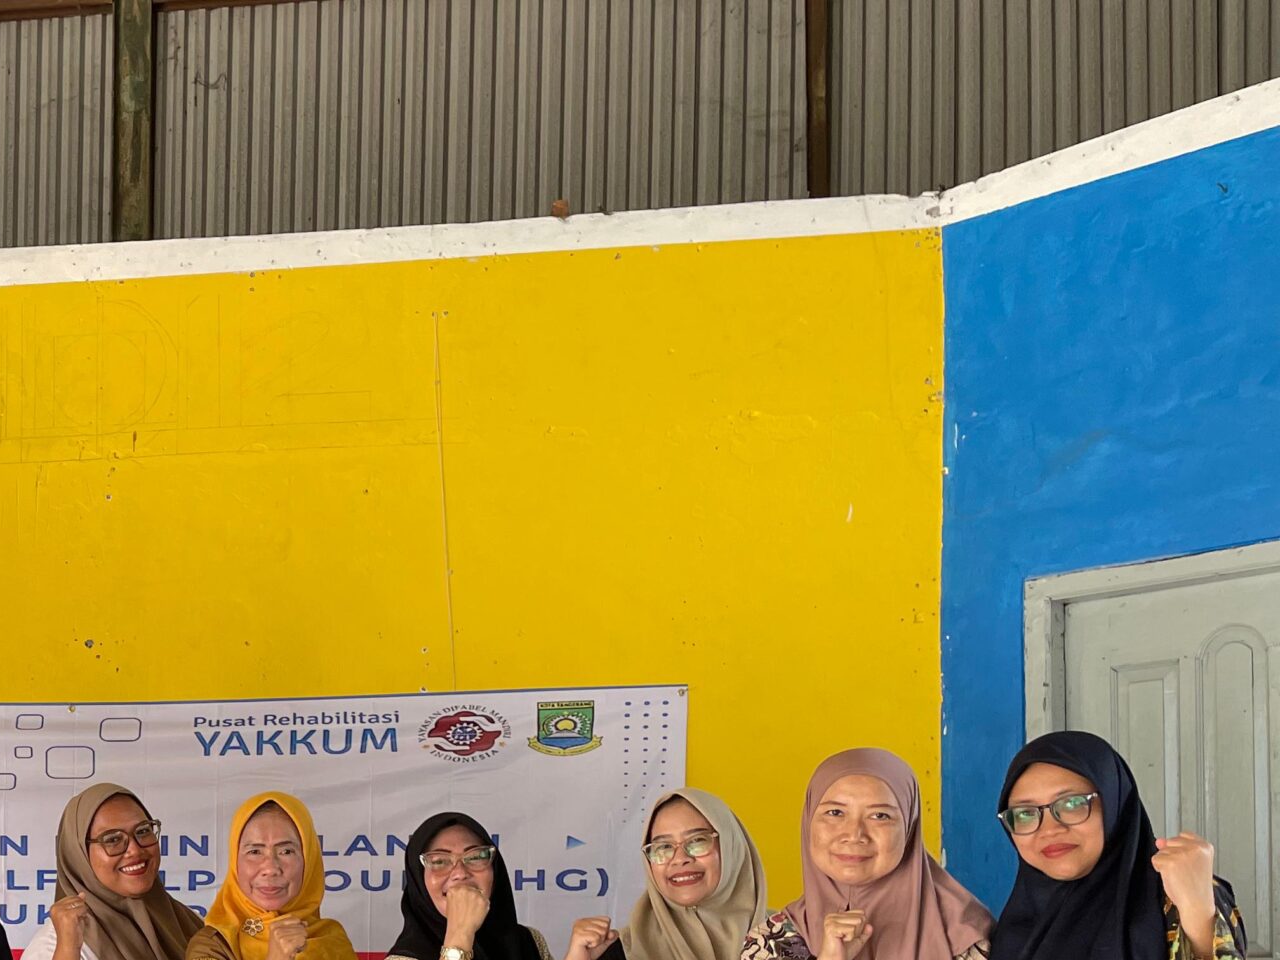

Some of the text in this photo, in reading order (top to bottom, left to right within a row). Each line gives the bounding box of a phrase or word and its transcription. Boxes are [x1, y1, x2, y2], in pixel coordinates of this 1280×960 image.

[194, 711, 400, 727] Pusat Rehabilitasi
[194, 728, 399, 756] YAKKUM
[430, 749, 499, 763] INDONESIA
